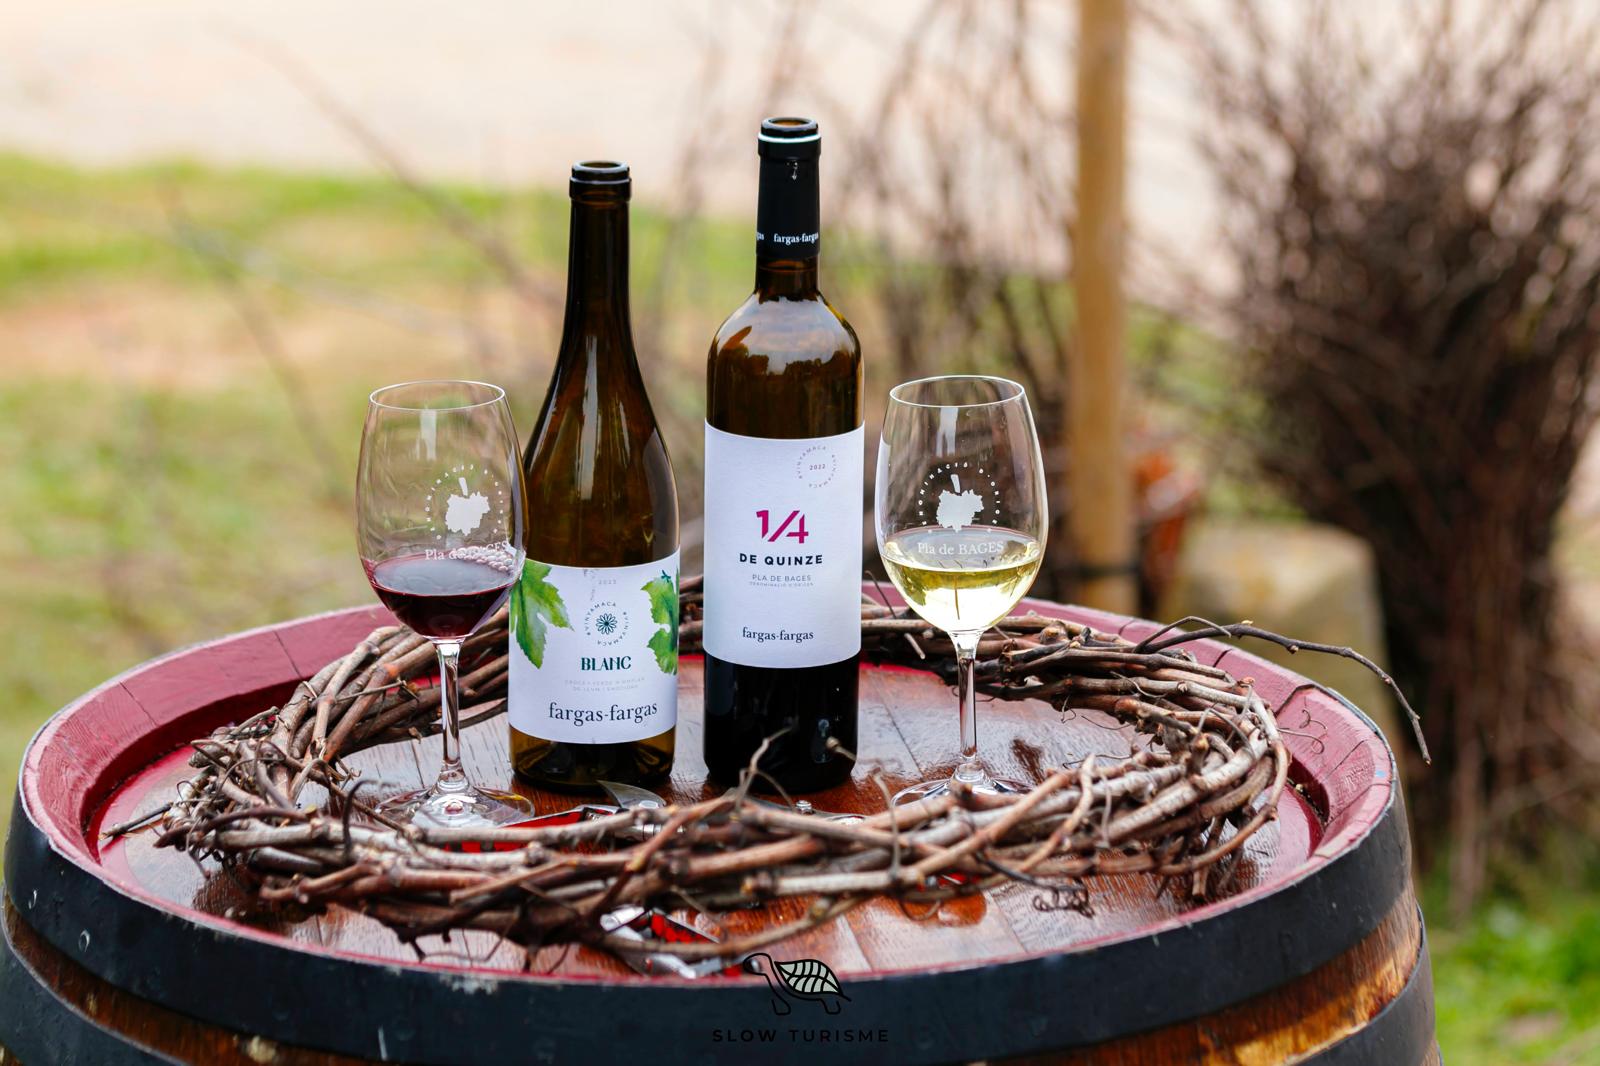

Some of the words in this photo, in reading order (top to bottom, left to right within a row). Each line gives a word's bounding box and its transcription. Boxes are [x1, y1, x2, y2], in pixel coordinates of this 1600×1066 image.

[756, 509, 809, 544] 1/4
[424, 548, 445, 560] Pla
[917, 542, 935, 555] Pla
[939, 543, 955, 555] de
[958, 540, 1004, 555] BAGES
[739, 553, 757, 564] DE
[764, 554, 823, 566] QUINZE
[752, 573, 768, 582] PLA
[784, 574, 812, 582] BAGES
[742, 626, 814, 643] fargas-fargas
[580, 656, 632, 671] BLANC
[549, 701, 658, 727] fargas-fargas
